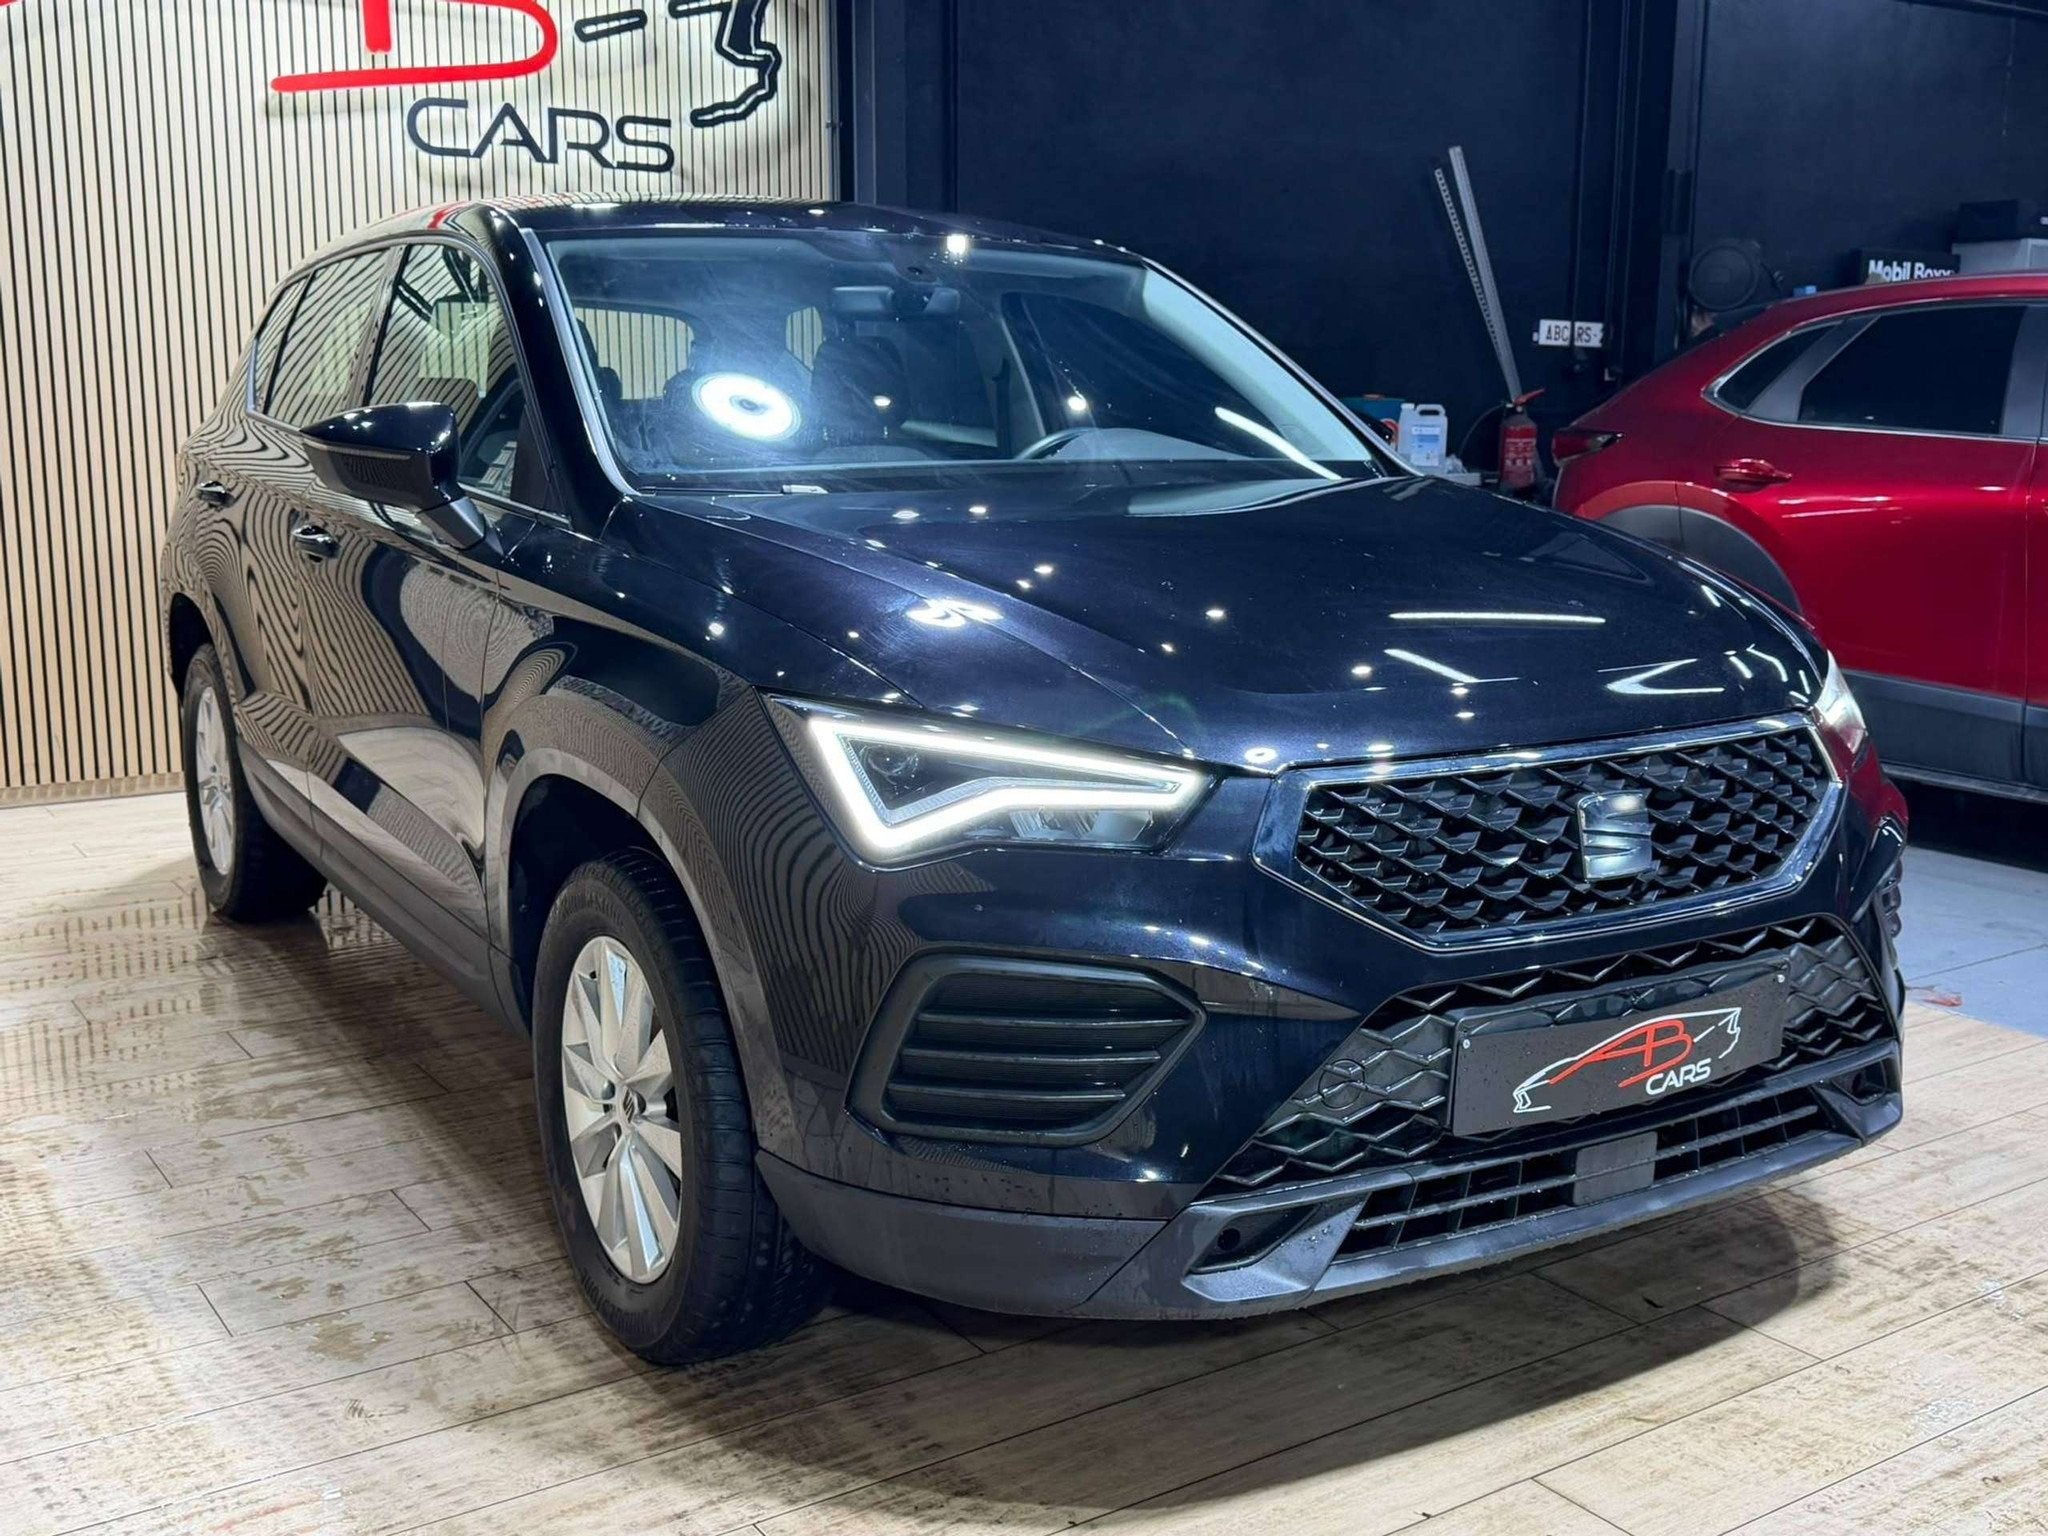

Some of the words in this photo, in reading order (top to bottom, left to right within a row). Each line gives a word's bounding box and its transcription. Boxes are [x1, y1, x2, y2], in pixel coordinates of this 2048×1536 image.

[407, 97, 675, 173] CARS
[1549, 1018, 1694, 1088] AB
[1646, 1058, 1712, 1095] CARS
